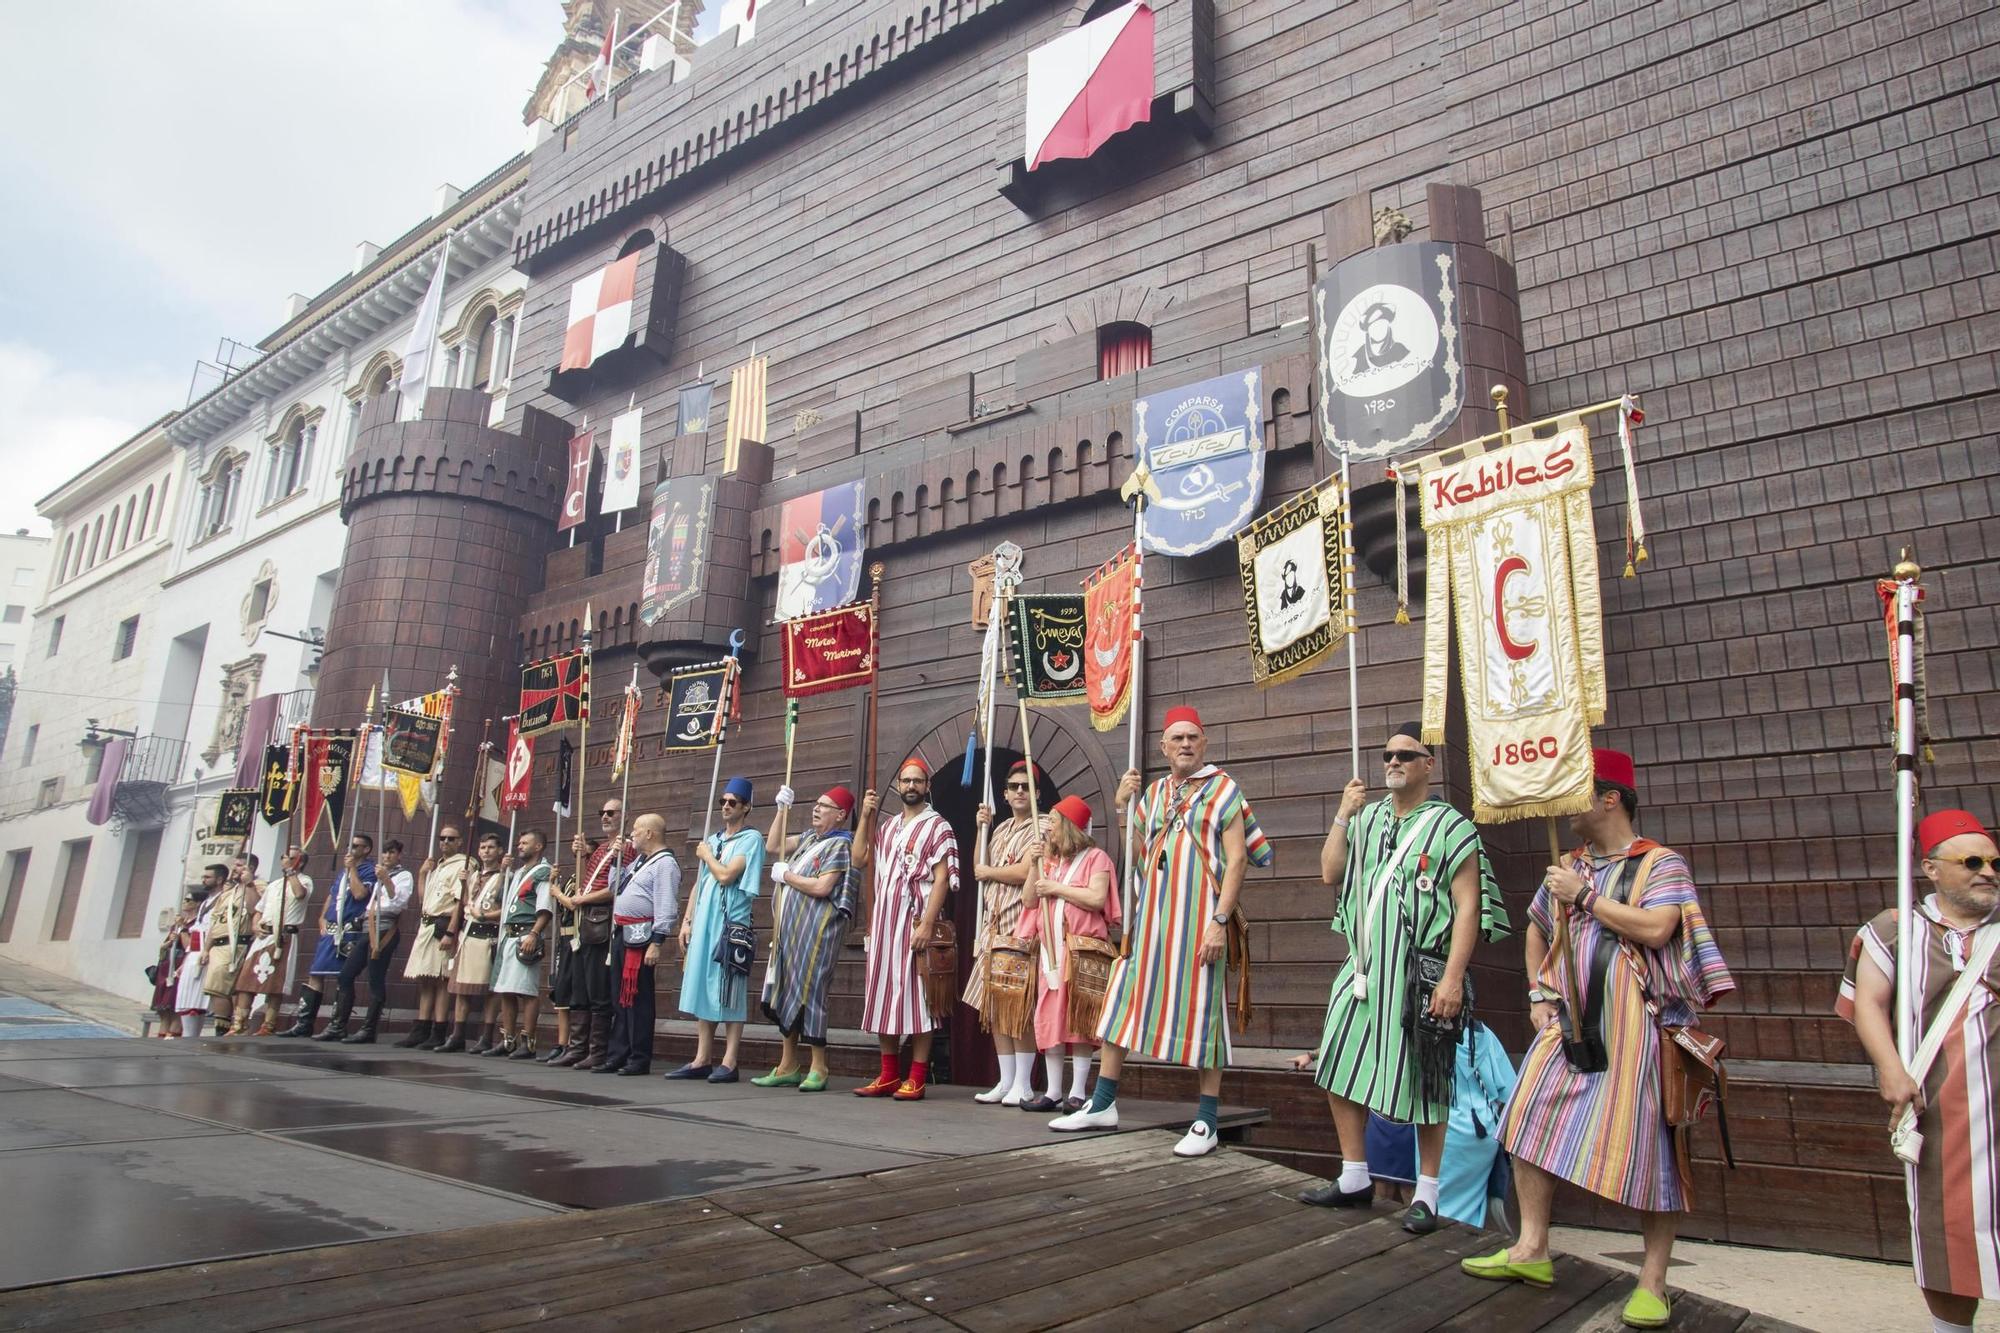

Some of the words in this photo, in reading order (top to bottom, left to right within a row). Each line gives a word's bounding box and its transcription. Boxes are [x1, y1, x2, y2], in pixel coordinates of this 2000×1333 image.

[1165, 396, 1224, 427] COMPARSA
[1429, 440, 1575, 512] Kabilas
[805, 637, 836, 649] Moros
[823, 647, 861, 661] Marinos
[1492, 736, 1558, 766] 1860
